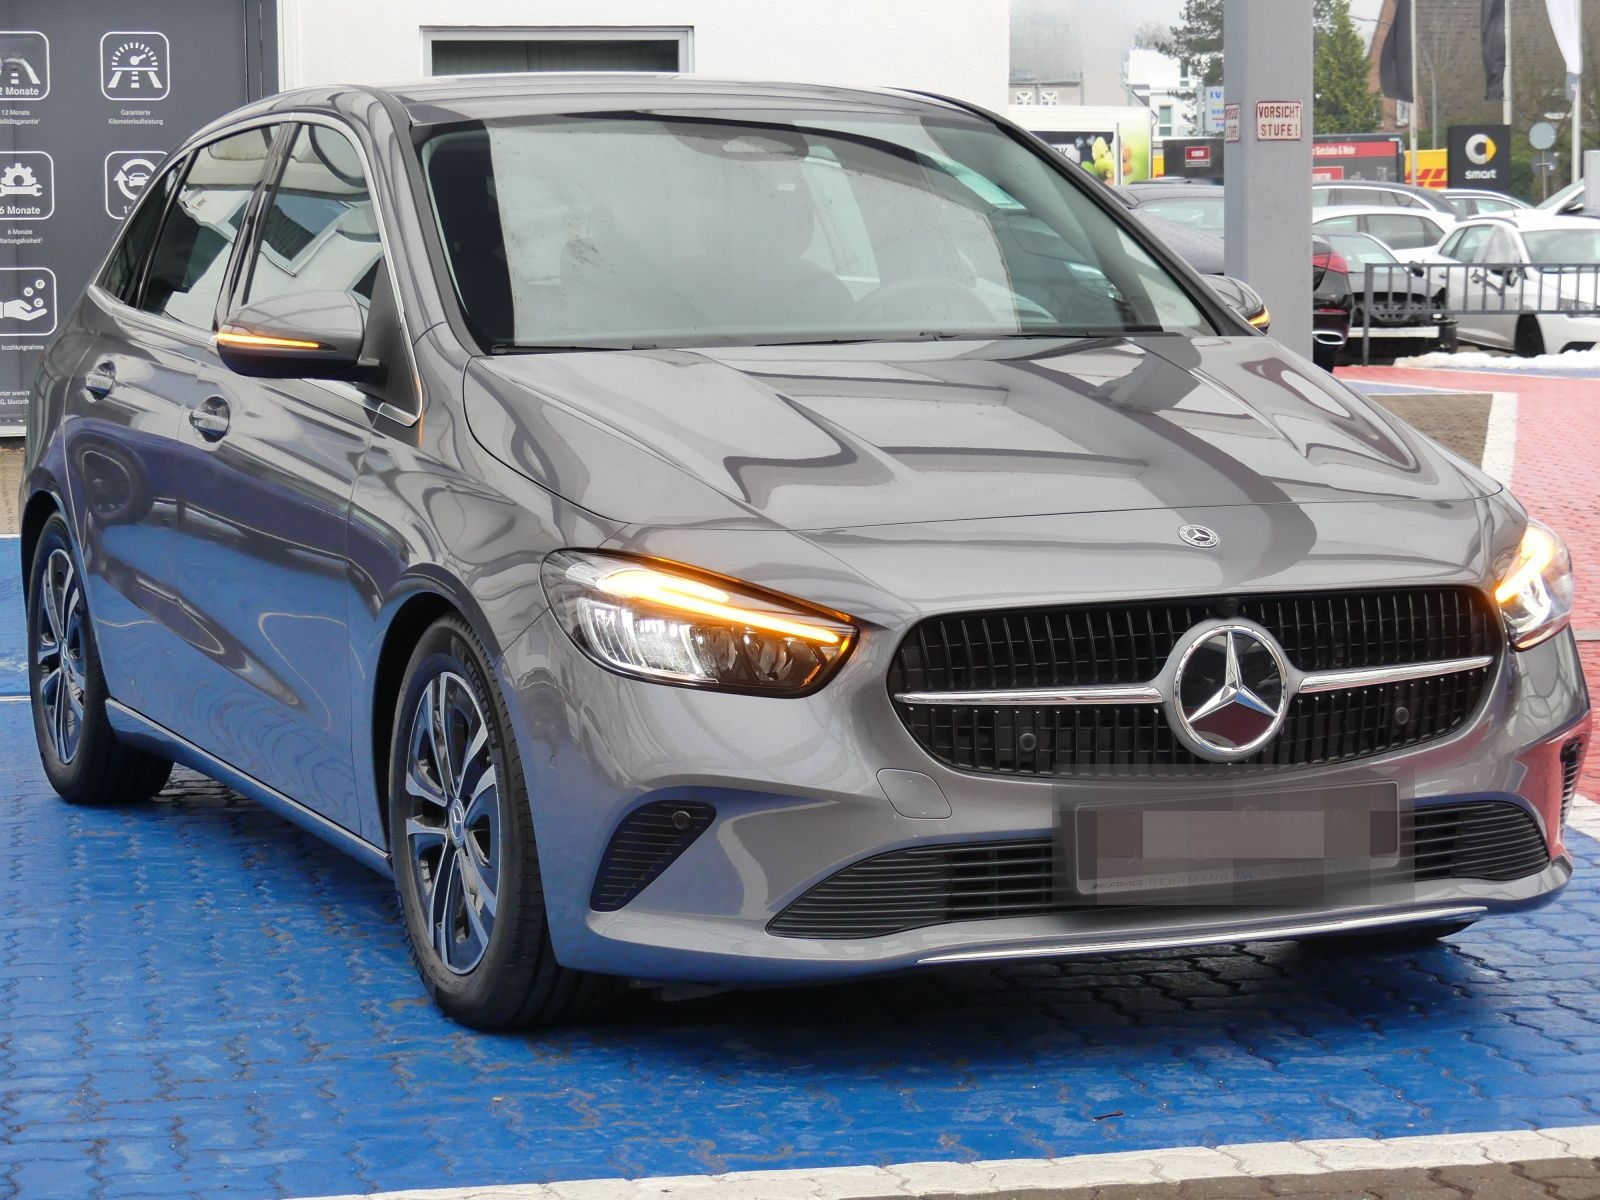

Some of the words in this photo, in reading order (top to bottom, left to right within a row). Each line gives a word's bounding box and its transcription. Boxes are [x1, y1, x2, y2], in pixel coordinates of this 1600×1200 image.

[5, 87, 39, 96] Monate
[1258, 106, 1300, 119] VORSICHT
[1260, 124, 1298, 136] STUFE!
[1464, 169, 1497, 179] smart
[7, 206, 41, 215] Monate
